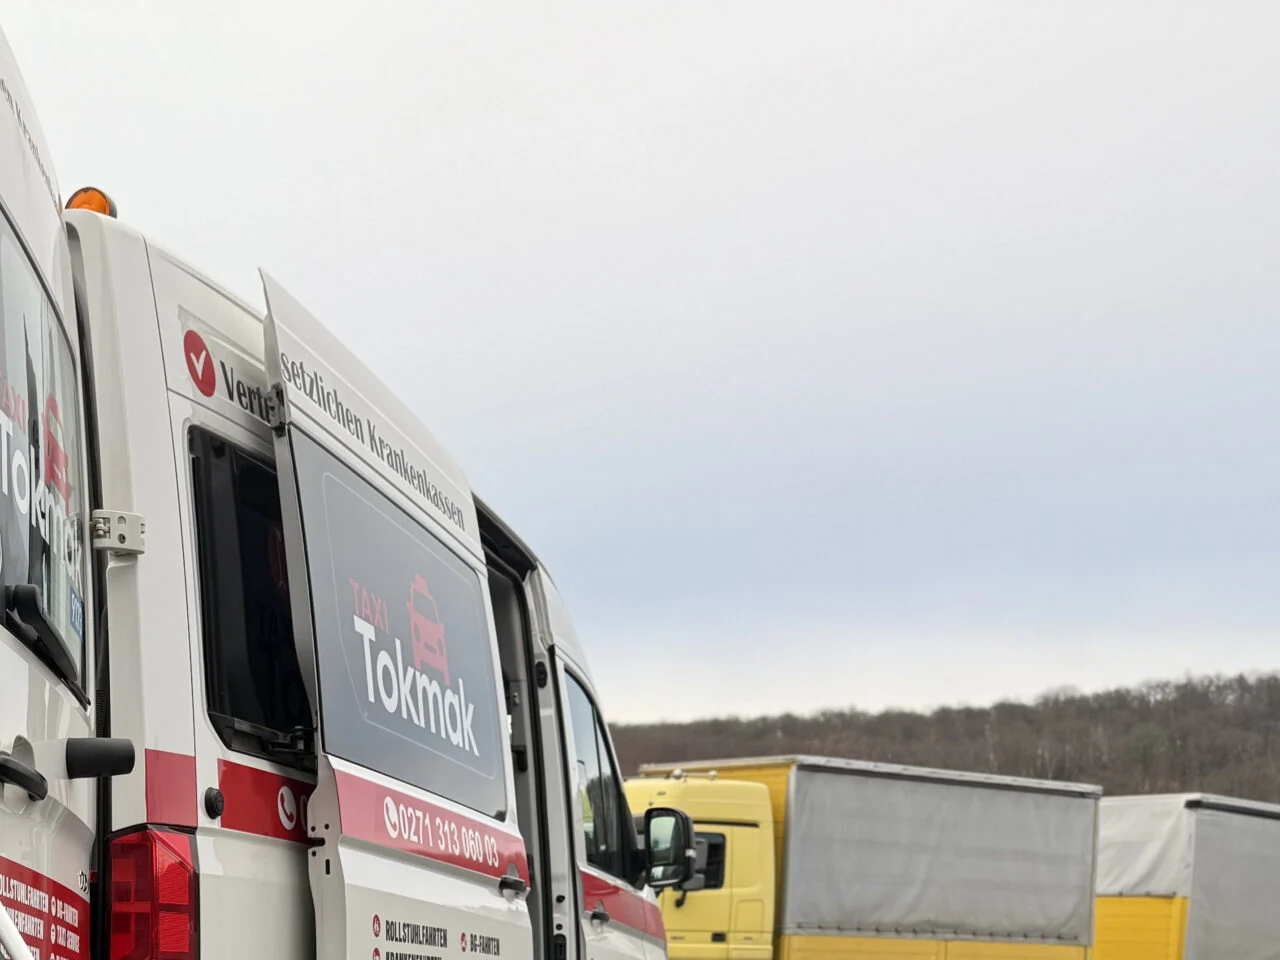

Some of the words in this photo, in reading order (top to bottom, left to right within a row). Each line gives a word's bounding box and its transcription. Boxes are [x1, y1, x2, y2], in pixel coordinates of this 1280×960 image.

[366, 418, 466, 532] Krankenkassen
[349, 578, 390, 634] TAXI
[353, 614, 480, 757] Tokmak
[399, 803, 433, 848] 0271
[435, 817, 460, 856] 313
[461, 826, 484, 864] 060
[484, 834, 500, 868] 03
[385, 919, 448, 949] ROLLSTUHLFAHRTEN
[470, 932, 500, 956] BG-FAHRTEN
